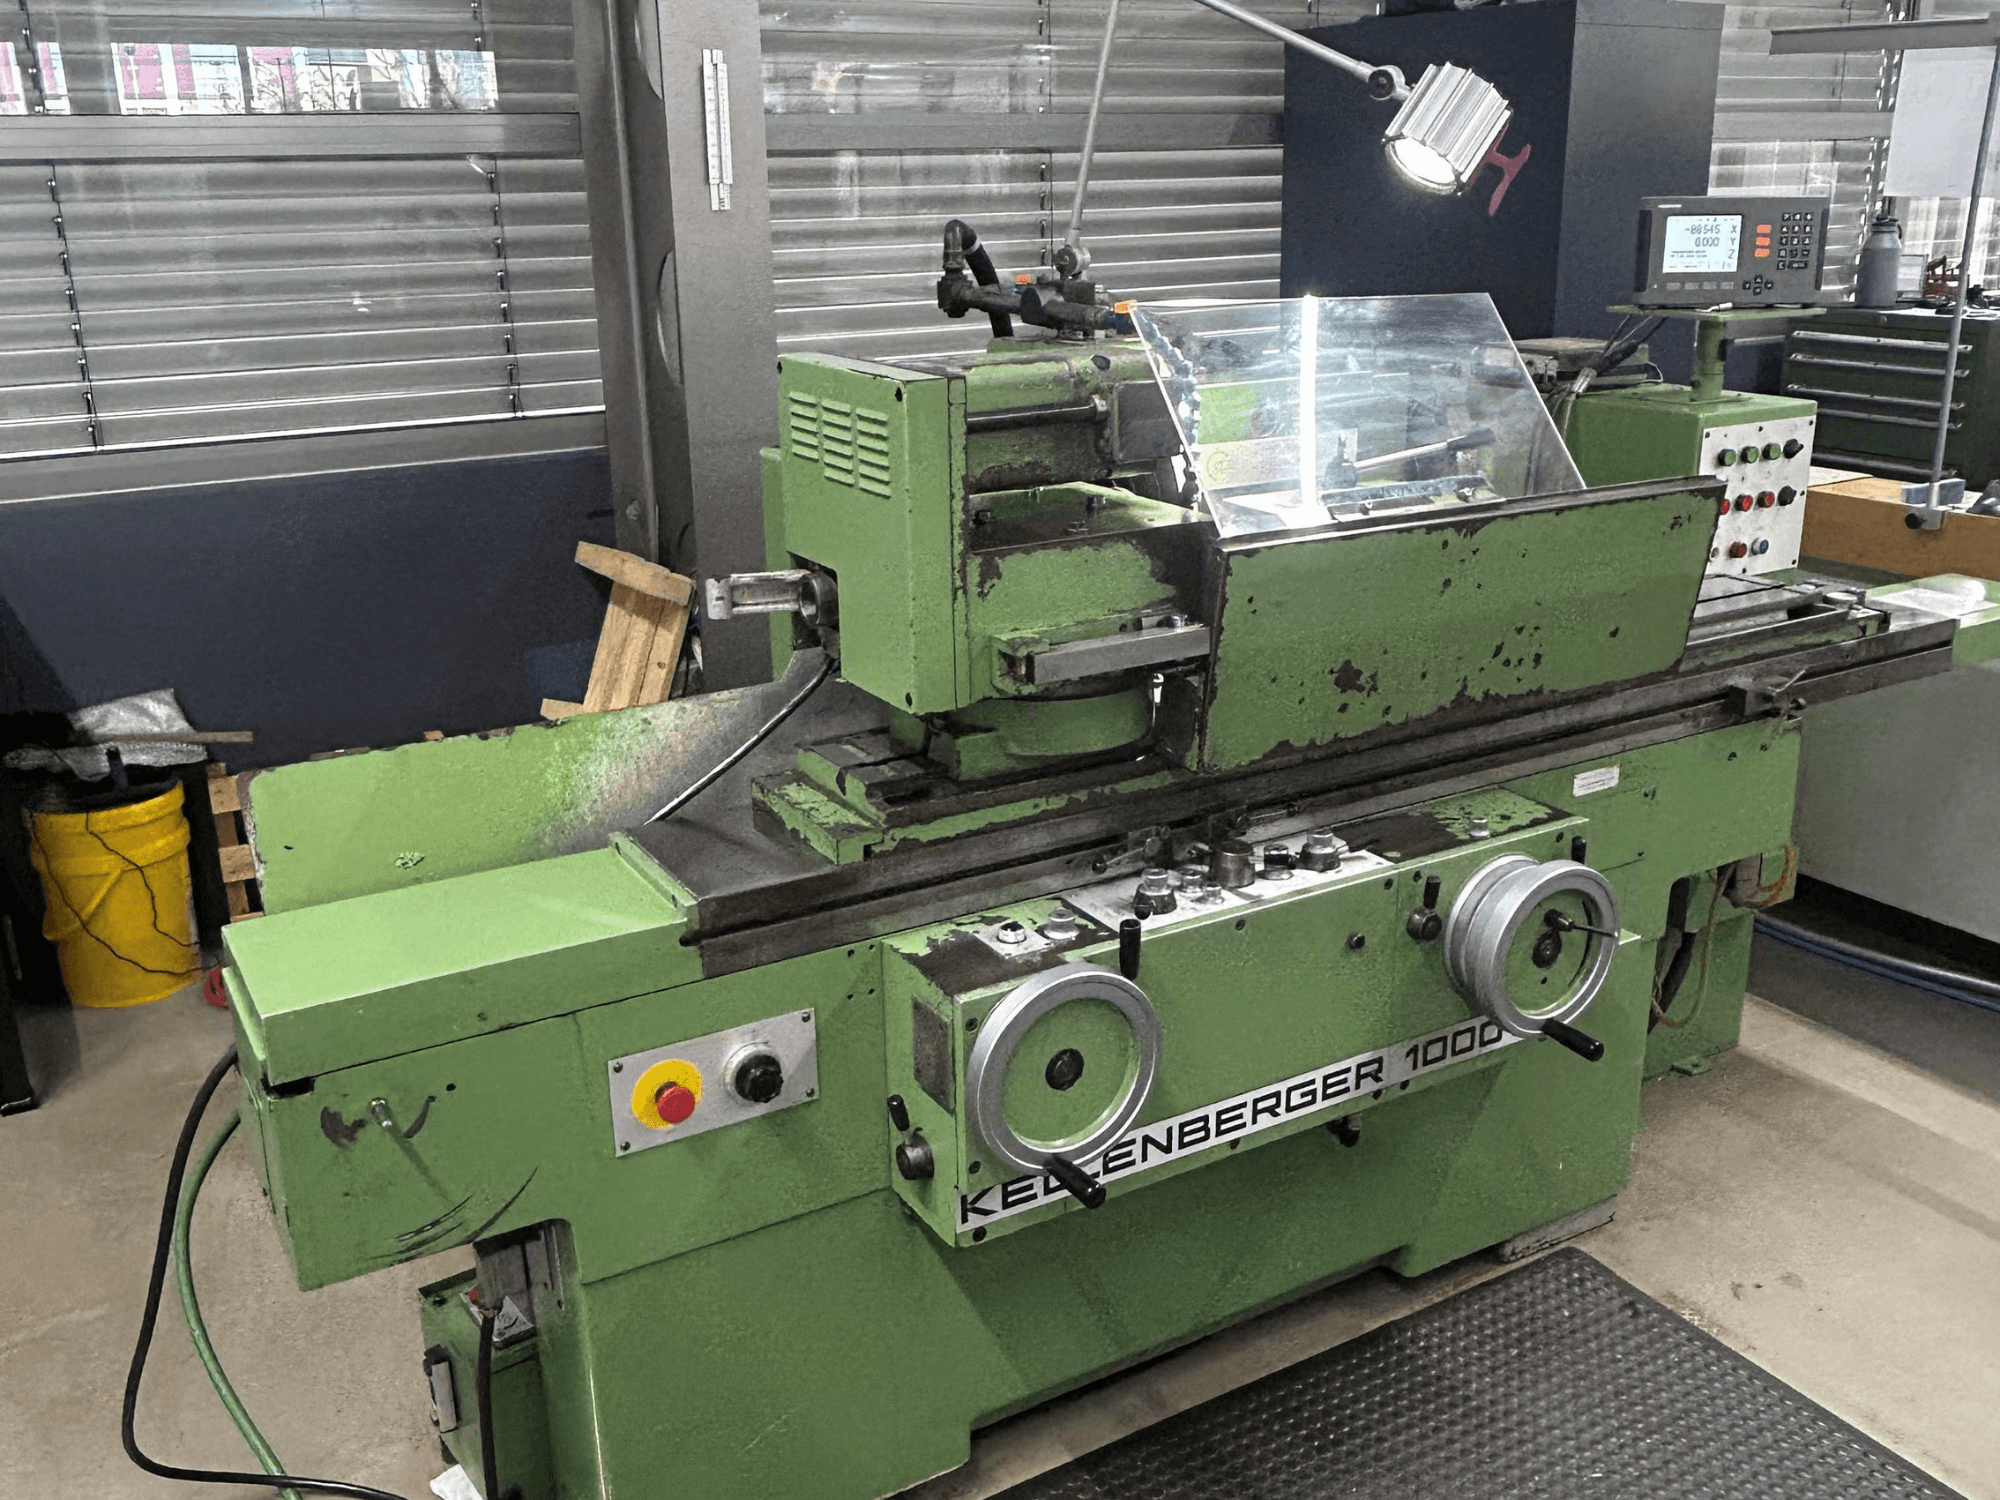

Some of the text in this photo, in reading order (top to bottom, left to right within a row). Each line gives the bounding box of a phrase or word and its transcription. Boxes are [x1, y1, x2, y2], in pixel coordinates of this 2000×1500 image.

[1730, 224, 1738, 234] X
[1730, 237, 1737, 246] Y
[1728, 249, 1736, 259] Z
[960, 1020, 1502, 1225] KELENBERGER 1000
